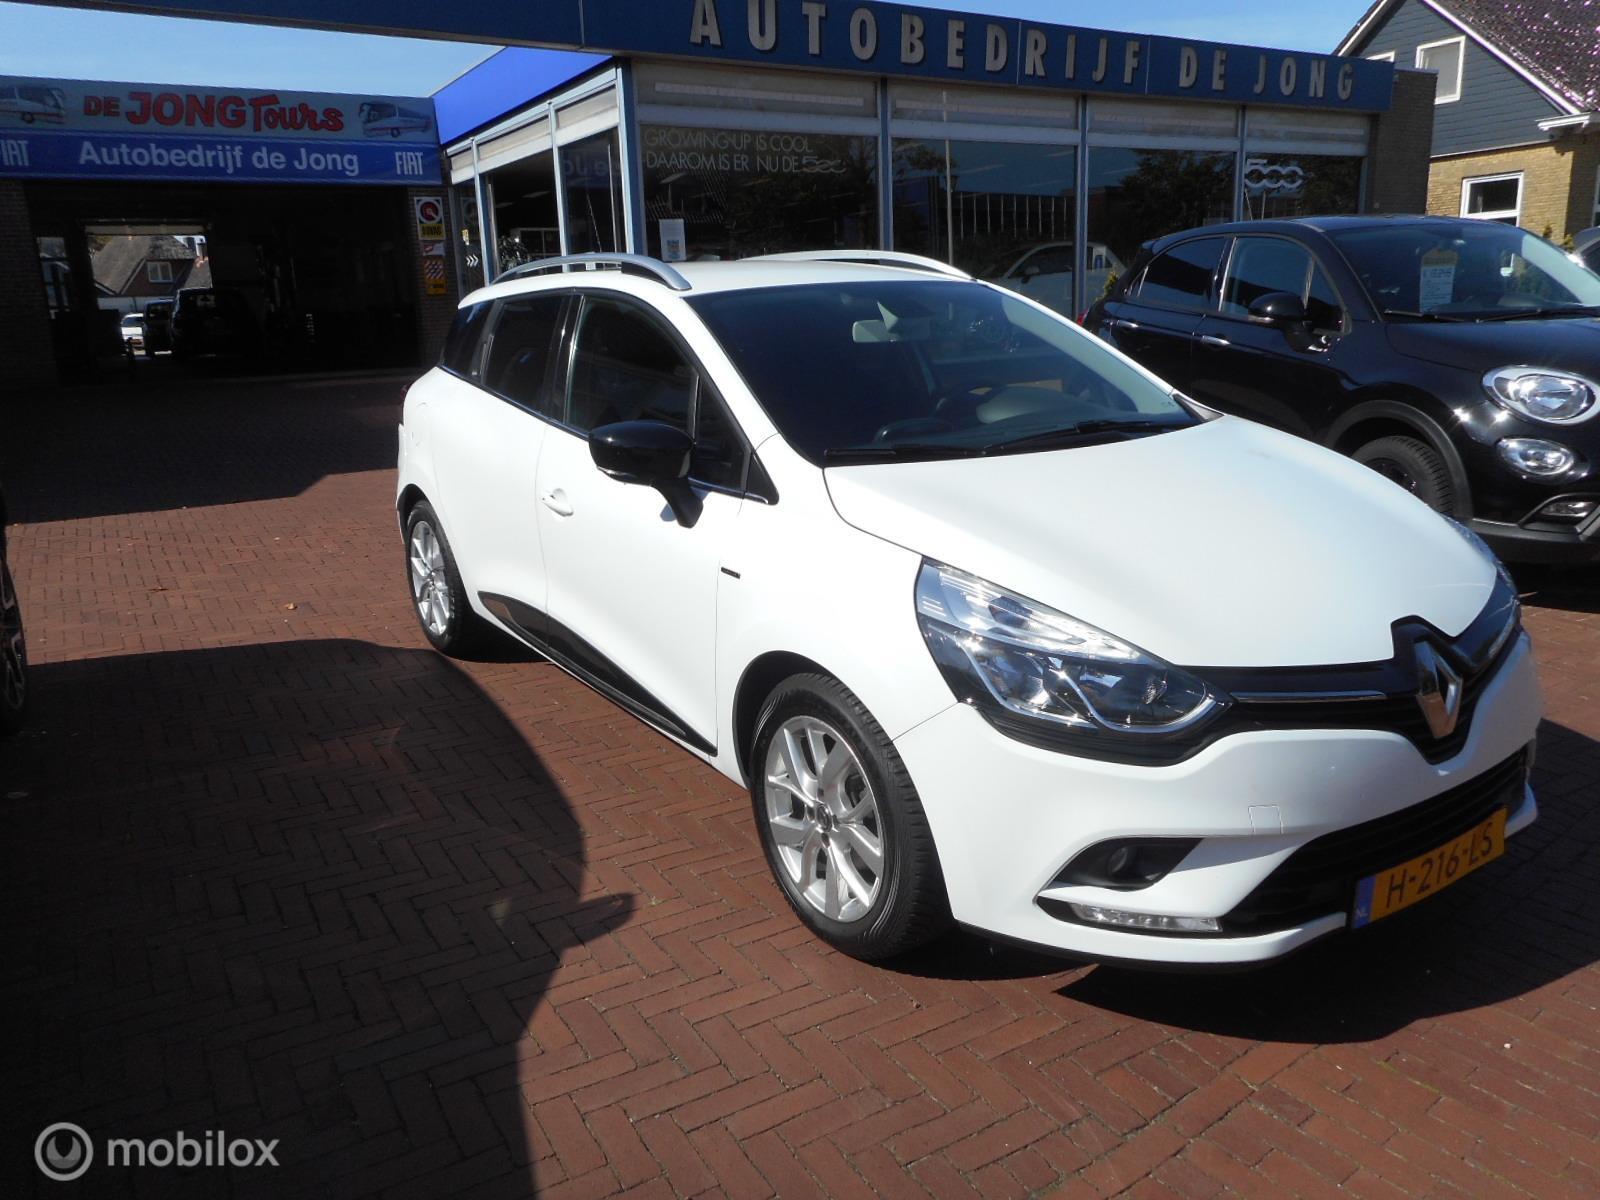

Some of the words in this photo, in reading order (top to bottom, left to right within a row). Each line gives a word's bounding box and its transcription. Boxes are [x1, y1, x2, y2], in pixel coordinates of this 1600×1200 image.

[689, 0, 1140, 84] AUTOBEDRIJF
[1178, 46, 1227, 91] DE
[1253, 54, 1353, 100] JONG
[84, 95, 121, 117] DE
[125, 91, 247, 129] JONG
[249, 93, 345, 132] Tours
[0, 139, 29, 167] IAT
[644, 128, 729, 150] GROWING
[756, 134, 768, 152] IS
[769, 134, 813, 153] COOL
[79, 140, 243, 175] Autobedrijf
[252, 147, 288, 169] de
[293, 147, 360, 177] Jong
[395, 151, 424, 175] FIAT
[646, 151, 717, 170] DAAROM
[718, 152, 730, 170] IS
[733, 153, 750, 172] ER
[756, 155, 779, 174] NU
[782, 155, 799, 173] DE
[1244, 158, 1304, 188] 500
[1386, 821, 1493, 908] H-216-LS
